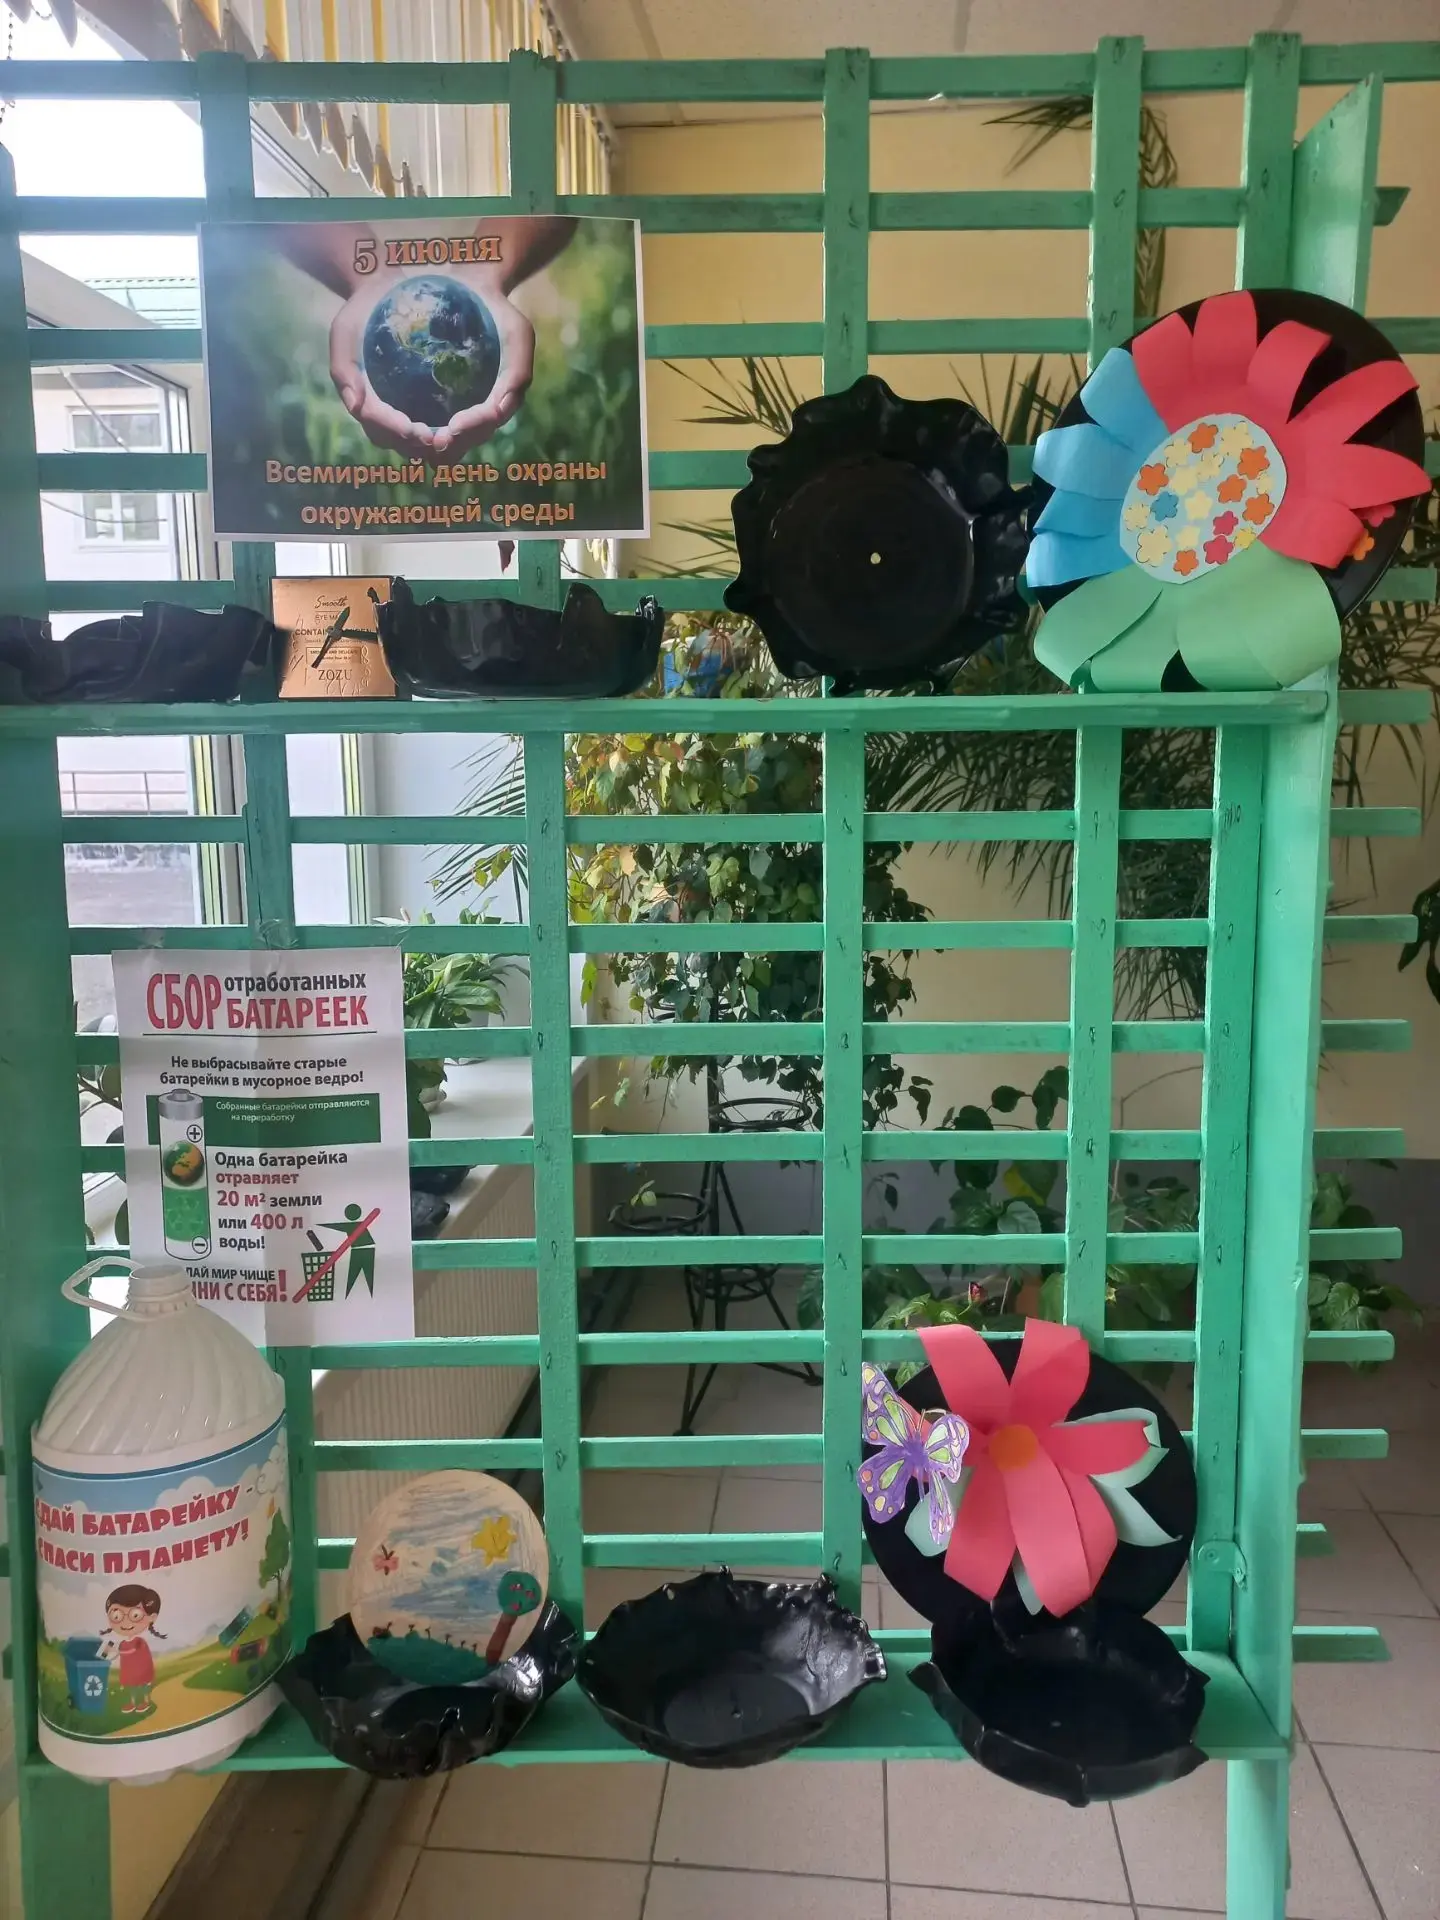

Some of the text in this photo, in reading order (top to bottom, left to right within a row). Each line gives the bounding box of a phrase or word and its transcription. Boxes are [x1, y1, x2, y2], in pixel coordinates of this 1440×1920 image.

[353, 239, 378, 274] 5
[265, 457, 606, 489] Всемирный день охраны
[301, 497, 575, 530] окружающей среды
[315, 595, 348, 608] Smooth
[295, 628, 325, 636] CONTAI
[318, 669, 352, 680] ZOZU
[146, 971, 367, 1030] СБОР отработанных
[226, 995, 369, 1029] БАТАРЕЕК
[171, 1056, 347, 1071] Не выбрасывайте старые
[159, 1071, 364, 1089] батарейки в мусорное ведро!
[216, 1100, 370, 1112] Собранные батарейки отправляются
[241, 1114, 295, 1123] переработку
[215, 1151, 348, 1169] Одна батарейка
[215, 1173, 299, 1187] отравляет
[217, 1190, 240, 1206] 20
[269, 1195, 322, 1207] земли
[218, 1213, 303, 1229] или 400 л
[219, 1236, 265, 1251] воды!
[211, 1268, 237, 1279] МИР
[240, 1269, 275, 1282] ЧИЩЕ
[224, 1283, 234, 1301] С
[82, 1485, 240, 1536] БАТАРЕЙКУ
[103, 1518, 249, 1574] ПЛАНЕТУ!
